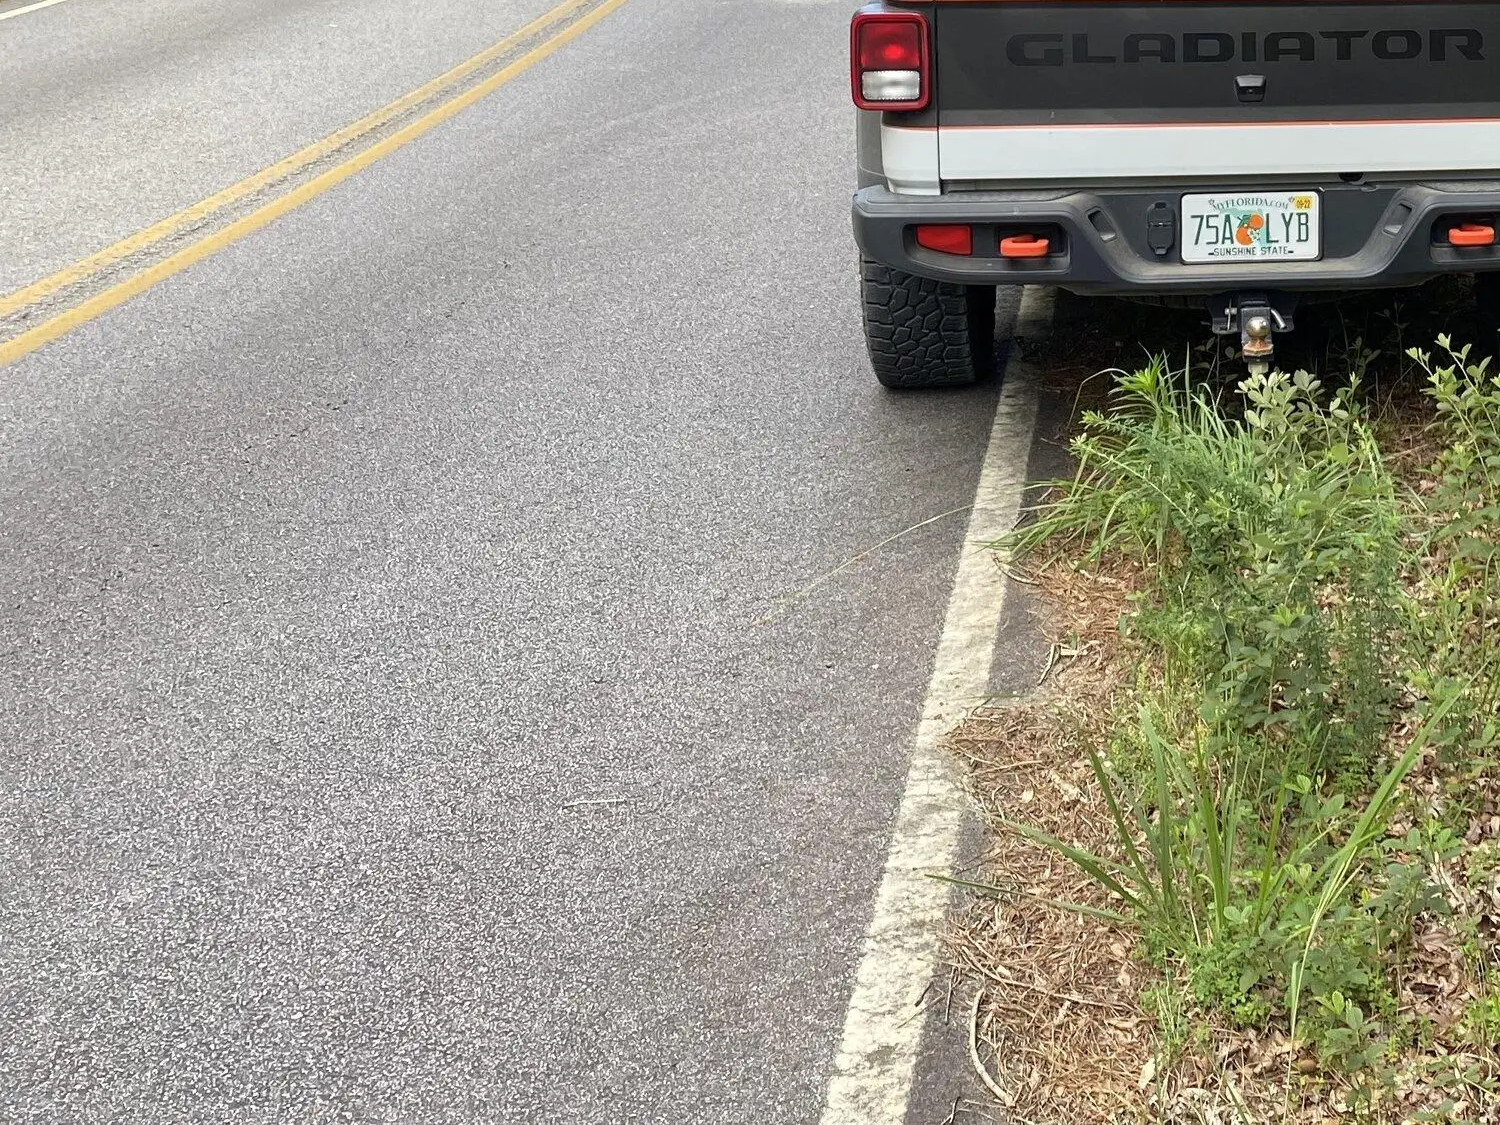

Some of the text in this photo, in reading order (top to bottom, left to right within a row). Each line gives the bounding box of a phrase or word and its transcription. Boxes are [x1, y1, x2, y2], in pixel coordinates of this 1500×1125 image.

[1006, 28, 1486, 67] GLADIATOR
[1190, 212, 1310, 246] 75A LYB
[1213, 246, 1288, 257] SUNSHINE STATE
